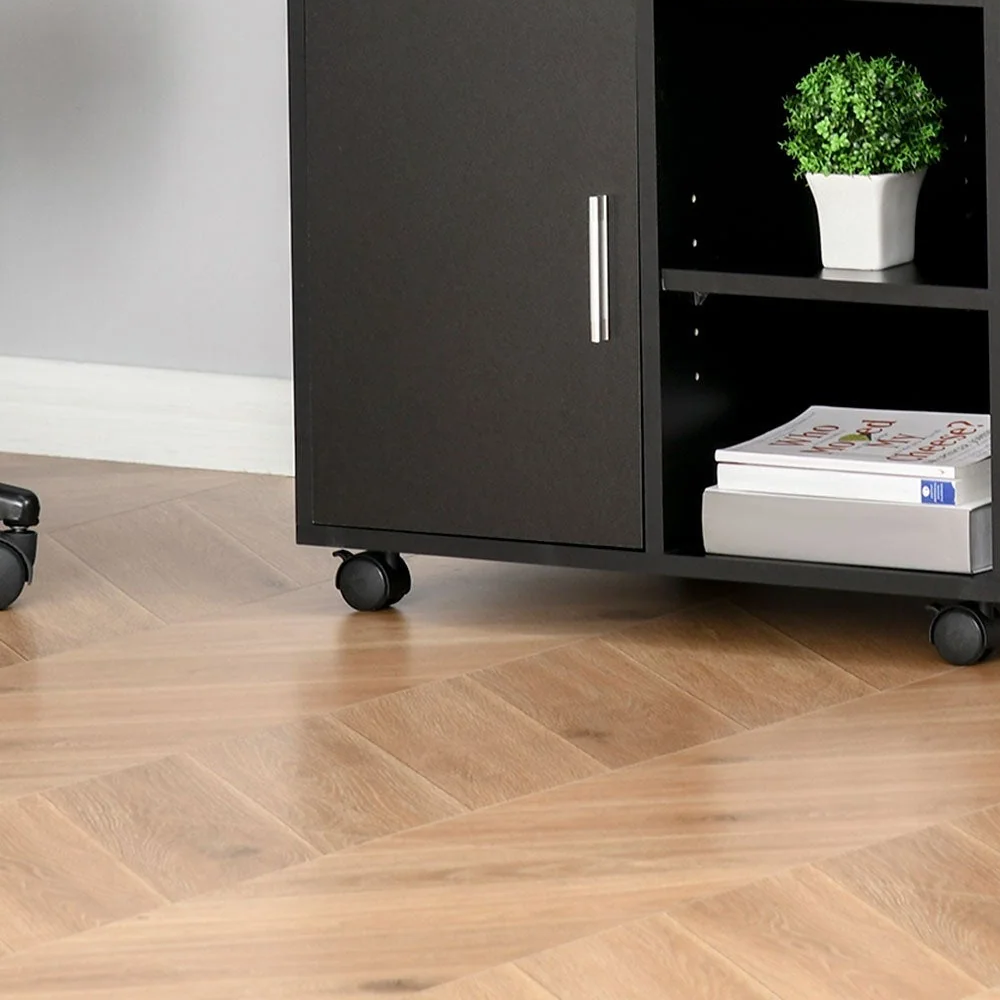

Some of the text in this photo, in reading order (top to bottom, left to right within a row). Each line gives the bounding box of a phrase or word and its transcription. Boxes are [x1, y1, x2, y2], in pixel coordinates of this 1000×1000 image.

[769, 424, 840, 447] Who
[799, 419, 897, 455] Moed
[866, 433, 925, 449] My
[886, 420, 984, 462] Cheese?
